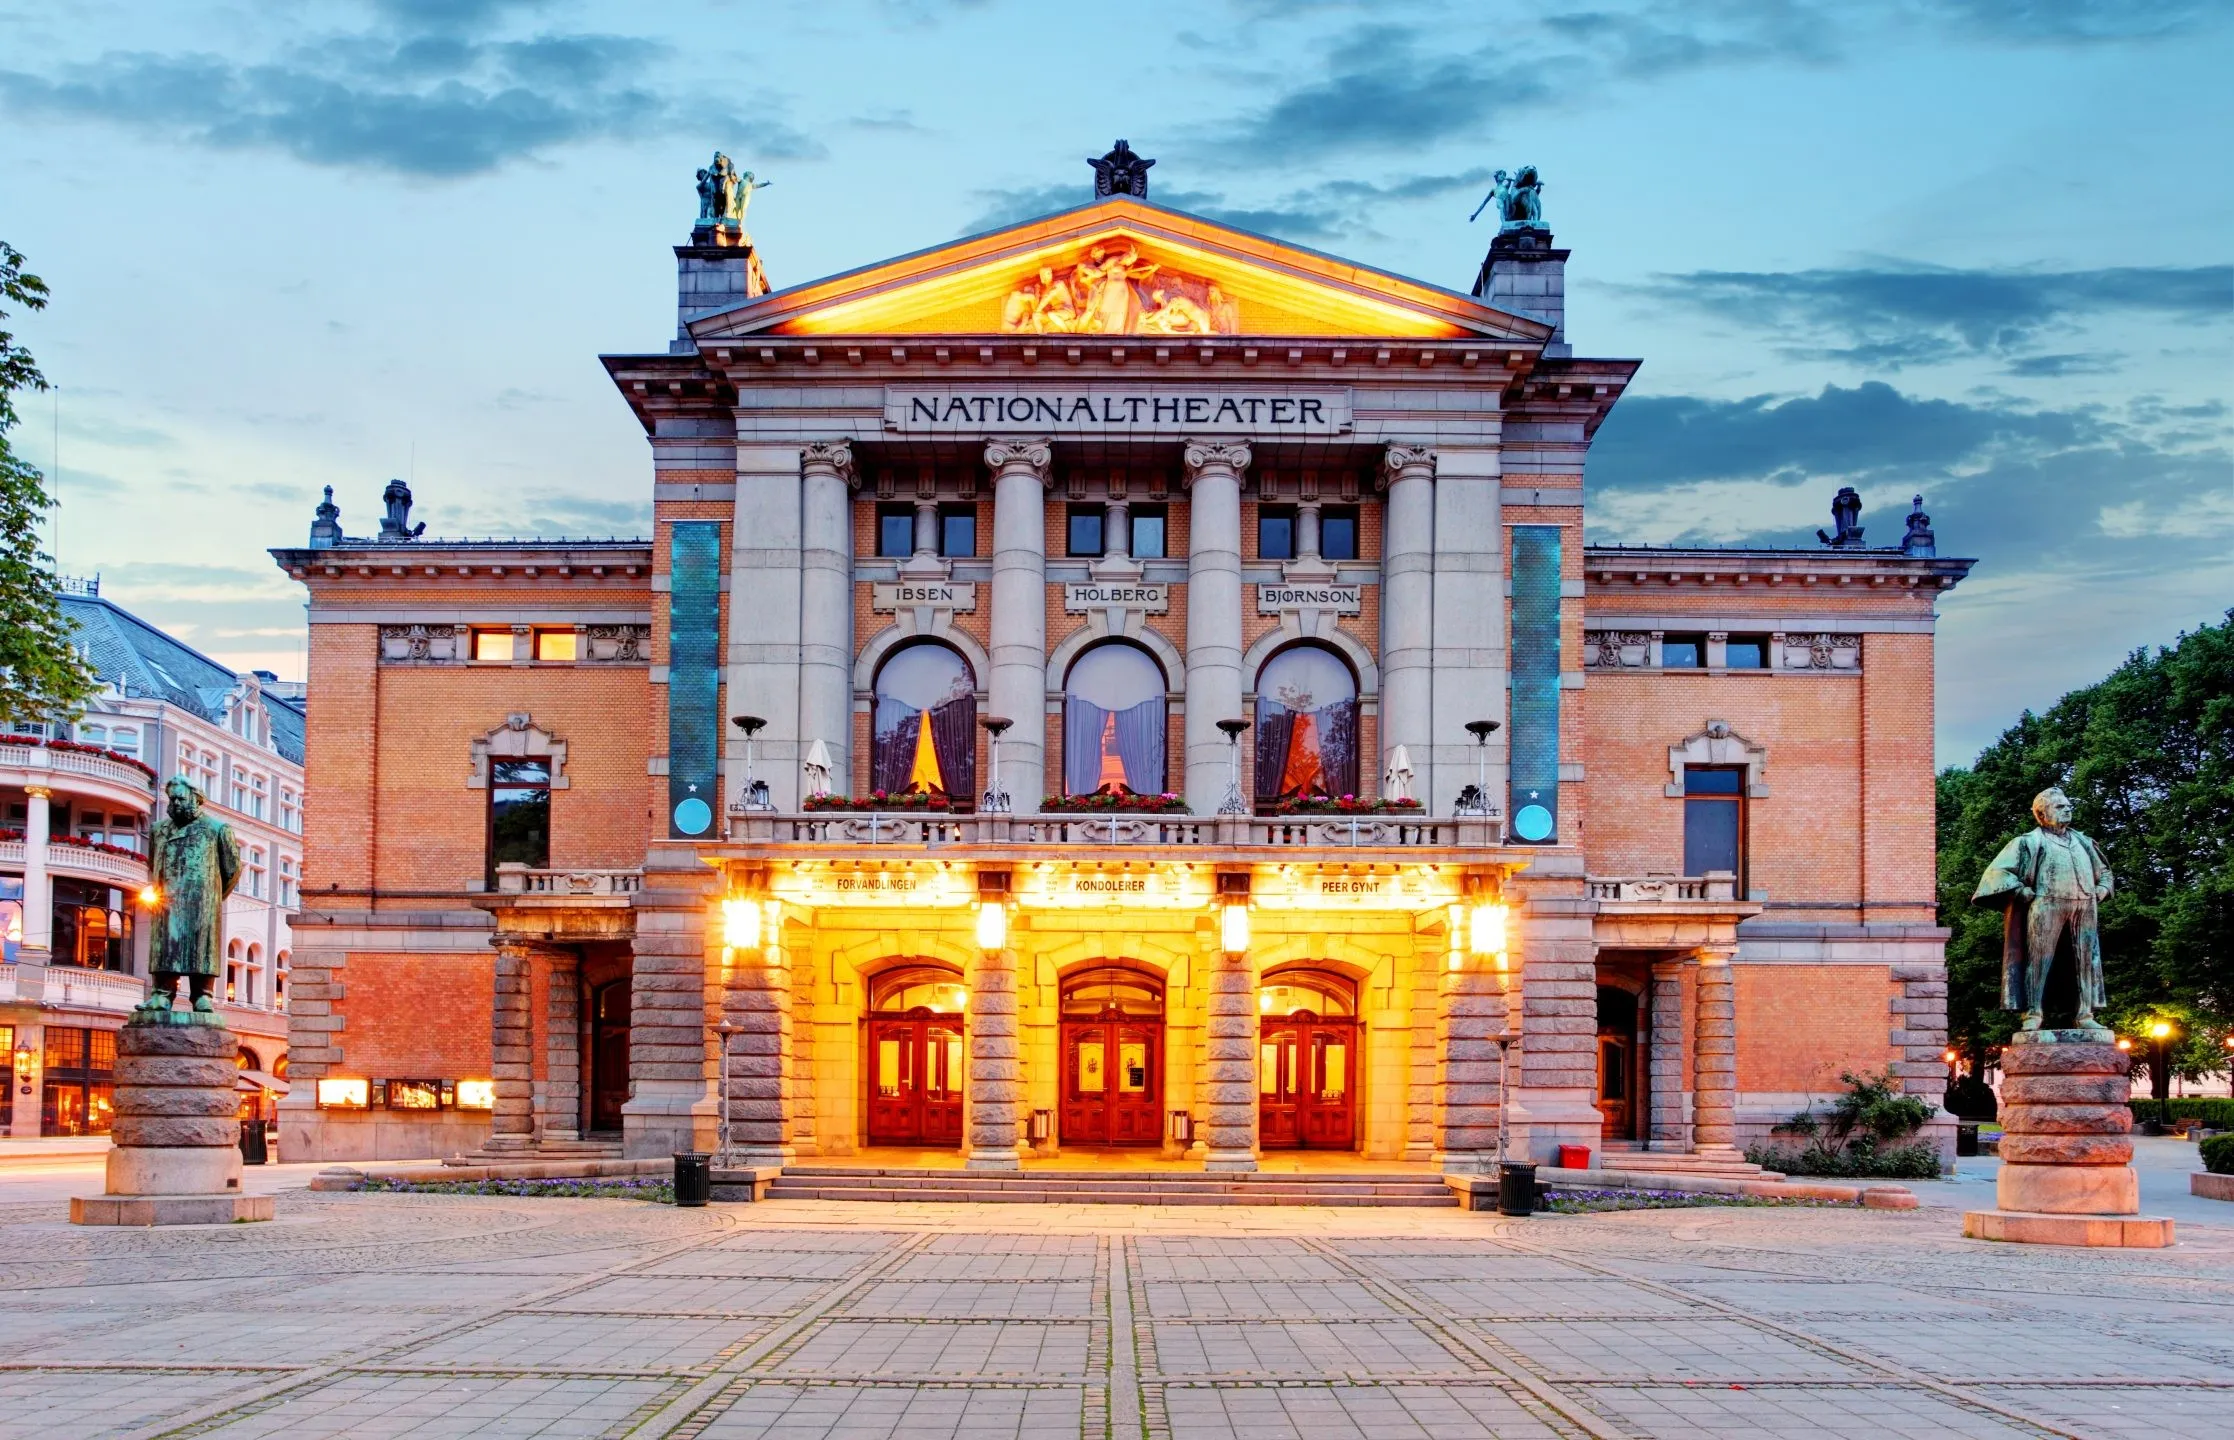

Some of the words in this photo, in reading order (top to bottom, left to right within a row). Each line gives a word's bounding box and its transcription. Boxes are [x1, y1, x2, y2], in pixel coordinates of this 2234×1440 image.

[911, 397, 1325, 424] NATIONALTHEATER
[896, 588, 953, 601] IBSEN
[1075, 589, 1159, 601] HOLBERG
[1265, 590, 1355, 604] BJØRNSON
[837, 878, 916, 890] FORVANDLINGEN
[1075, 880, 1145, 892] KONDOLERER
[1322, 882, 1348, 893] PEER
[1351, 882, 1380, 893] GYNT
